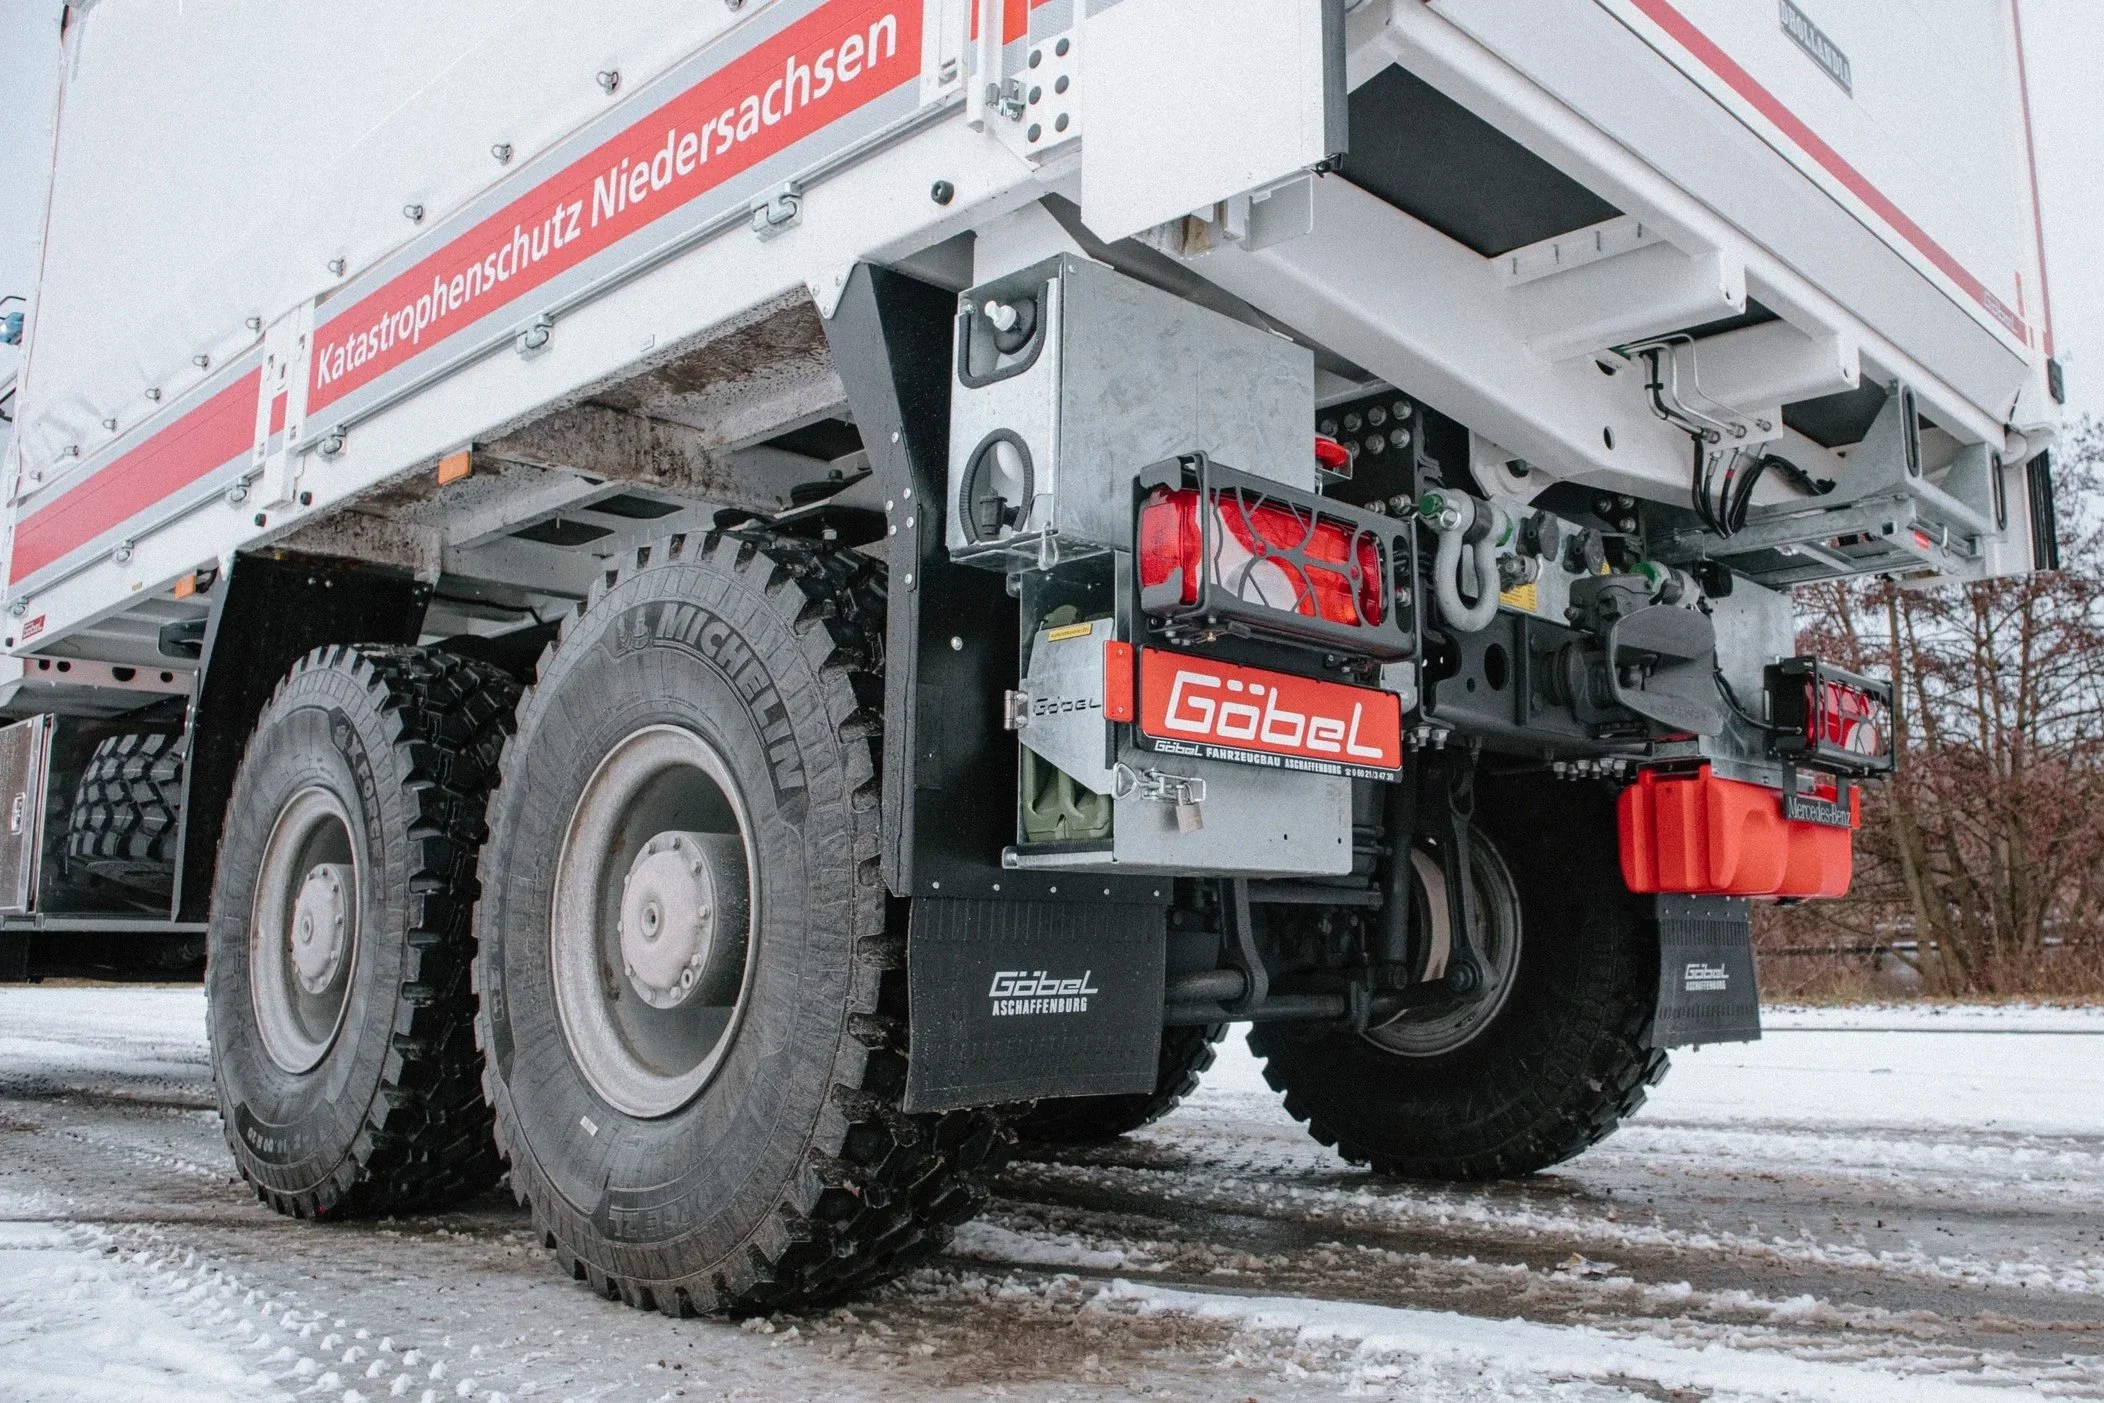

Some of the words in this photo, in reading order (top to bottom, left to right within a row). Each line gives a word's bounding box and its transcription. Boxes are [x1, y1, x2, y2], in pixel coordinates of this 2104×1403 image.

[317, 200, 582, 389] Katastrophenschutz
[591, 12, 896, 227] Niedersachsen
[656, 603, 805, 790] MICHELIN
[1206, 747, 1280, 767] FAHRZEUGBAU
[1284, 758, 1342, 775] ASCHAFFENBURG
[1788, 796, 1851, 827] Mercedes-Benz
[992, 997, 1088, 1016] ASCHAFFENBURG
